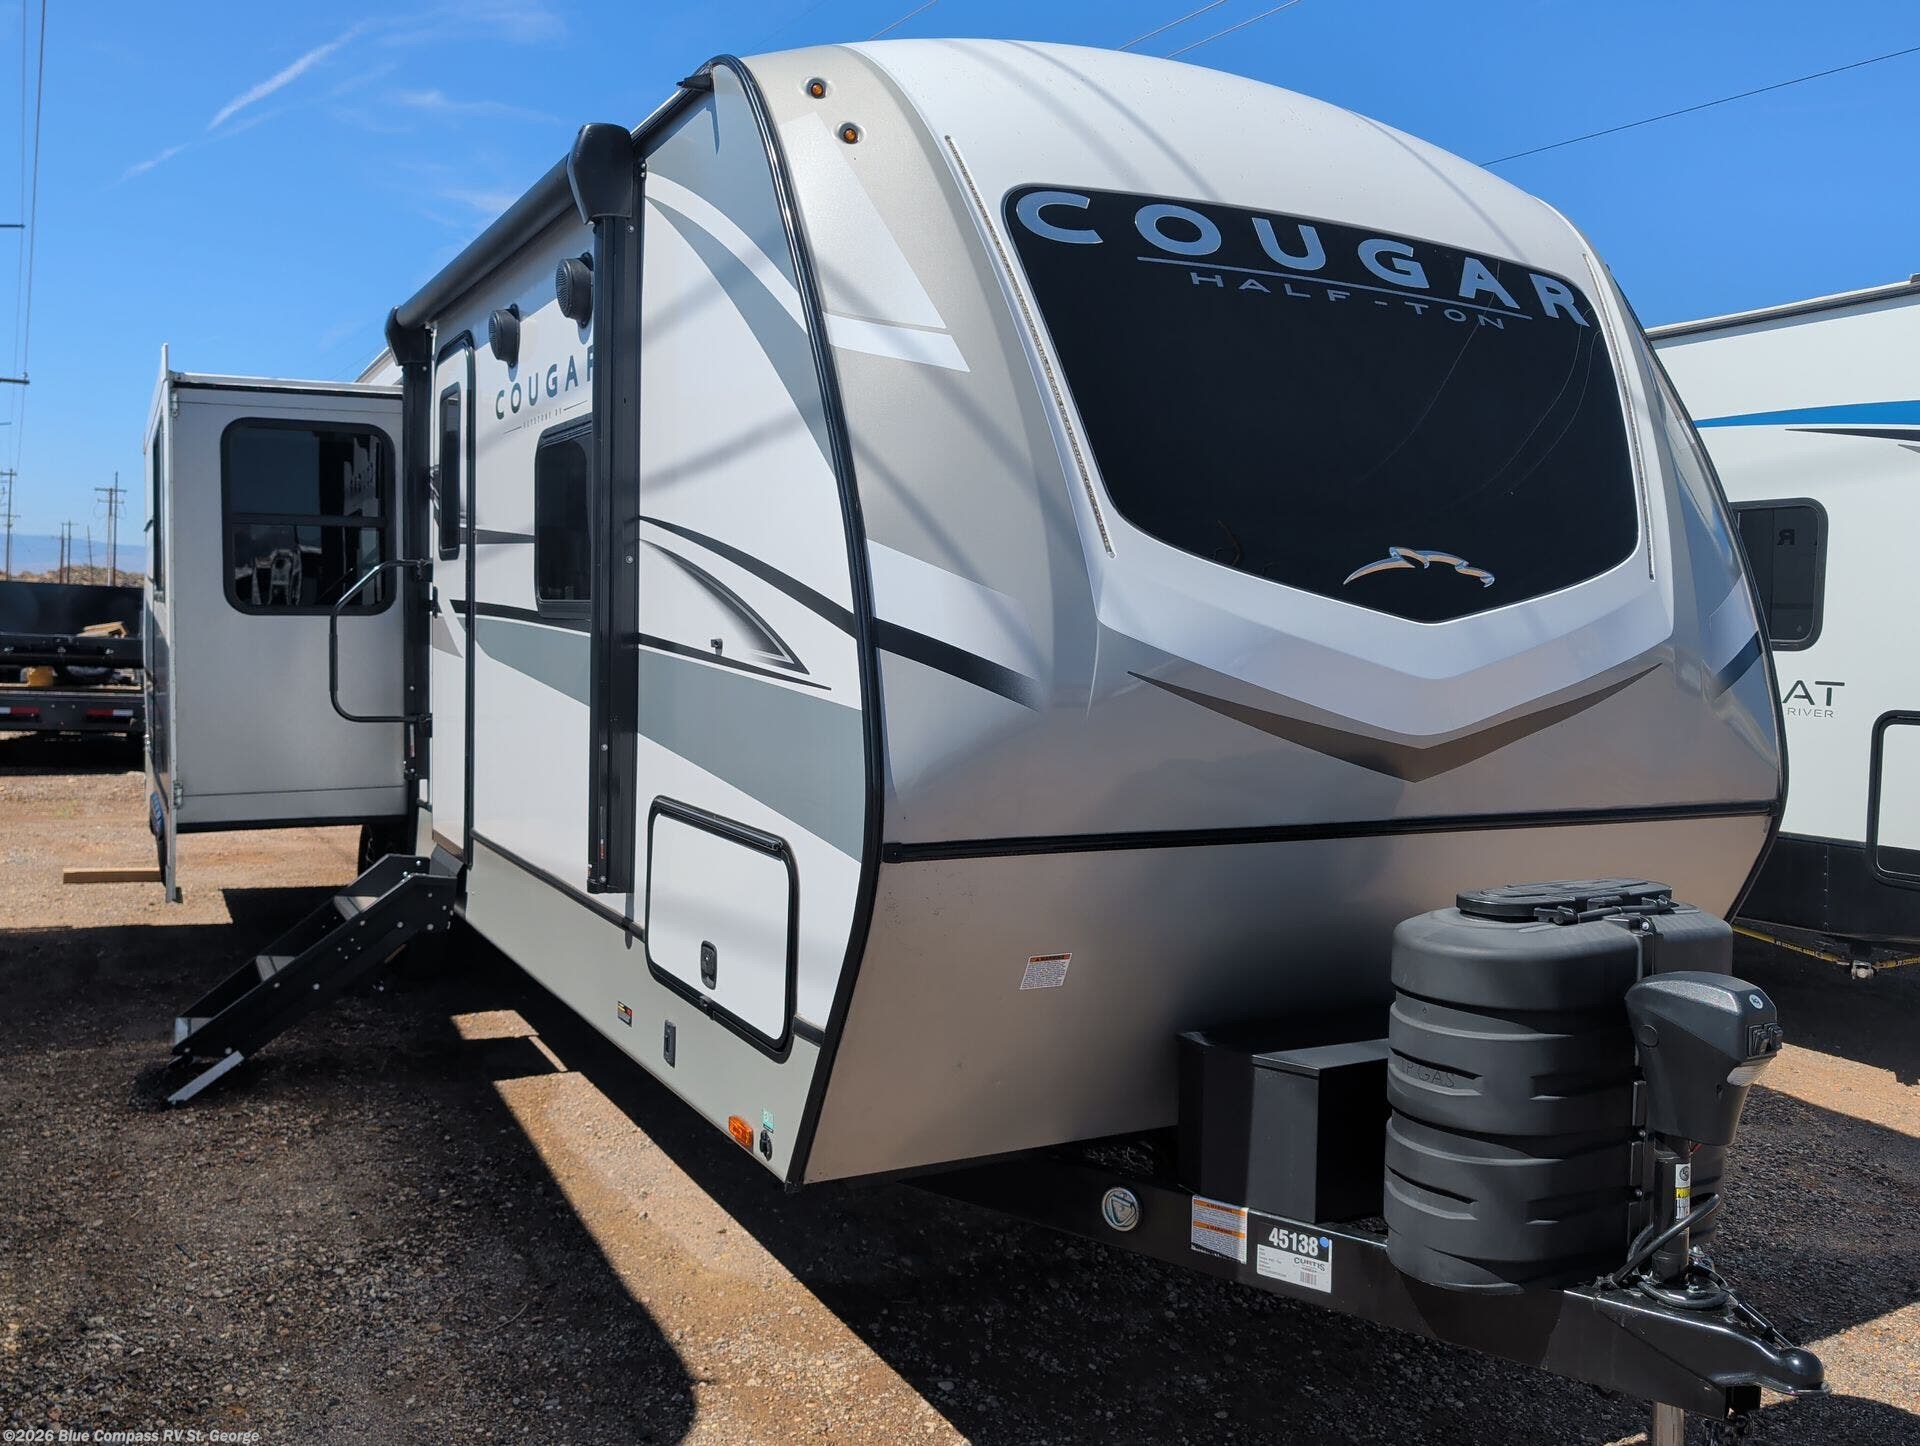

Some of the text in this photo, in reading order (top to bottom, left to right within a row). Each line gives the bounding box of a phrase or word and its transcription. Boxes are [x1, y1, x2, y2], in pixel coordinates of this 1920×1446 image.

[1015, 190, 1591, 327] COUGAR
[1191, 271, 1505, 330] HALF-TON
[1786, 707, 1835, 718] RIVER
[1416, 1066, 1456, 1088] GAS
[1268, 1227, 1319, 1257] 45138
[1293, 1256, 1327, 1272] CURTIS
